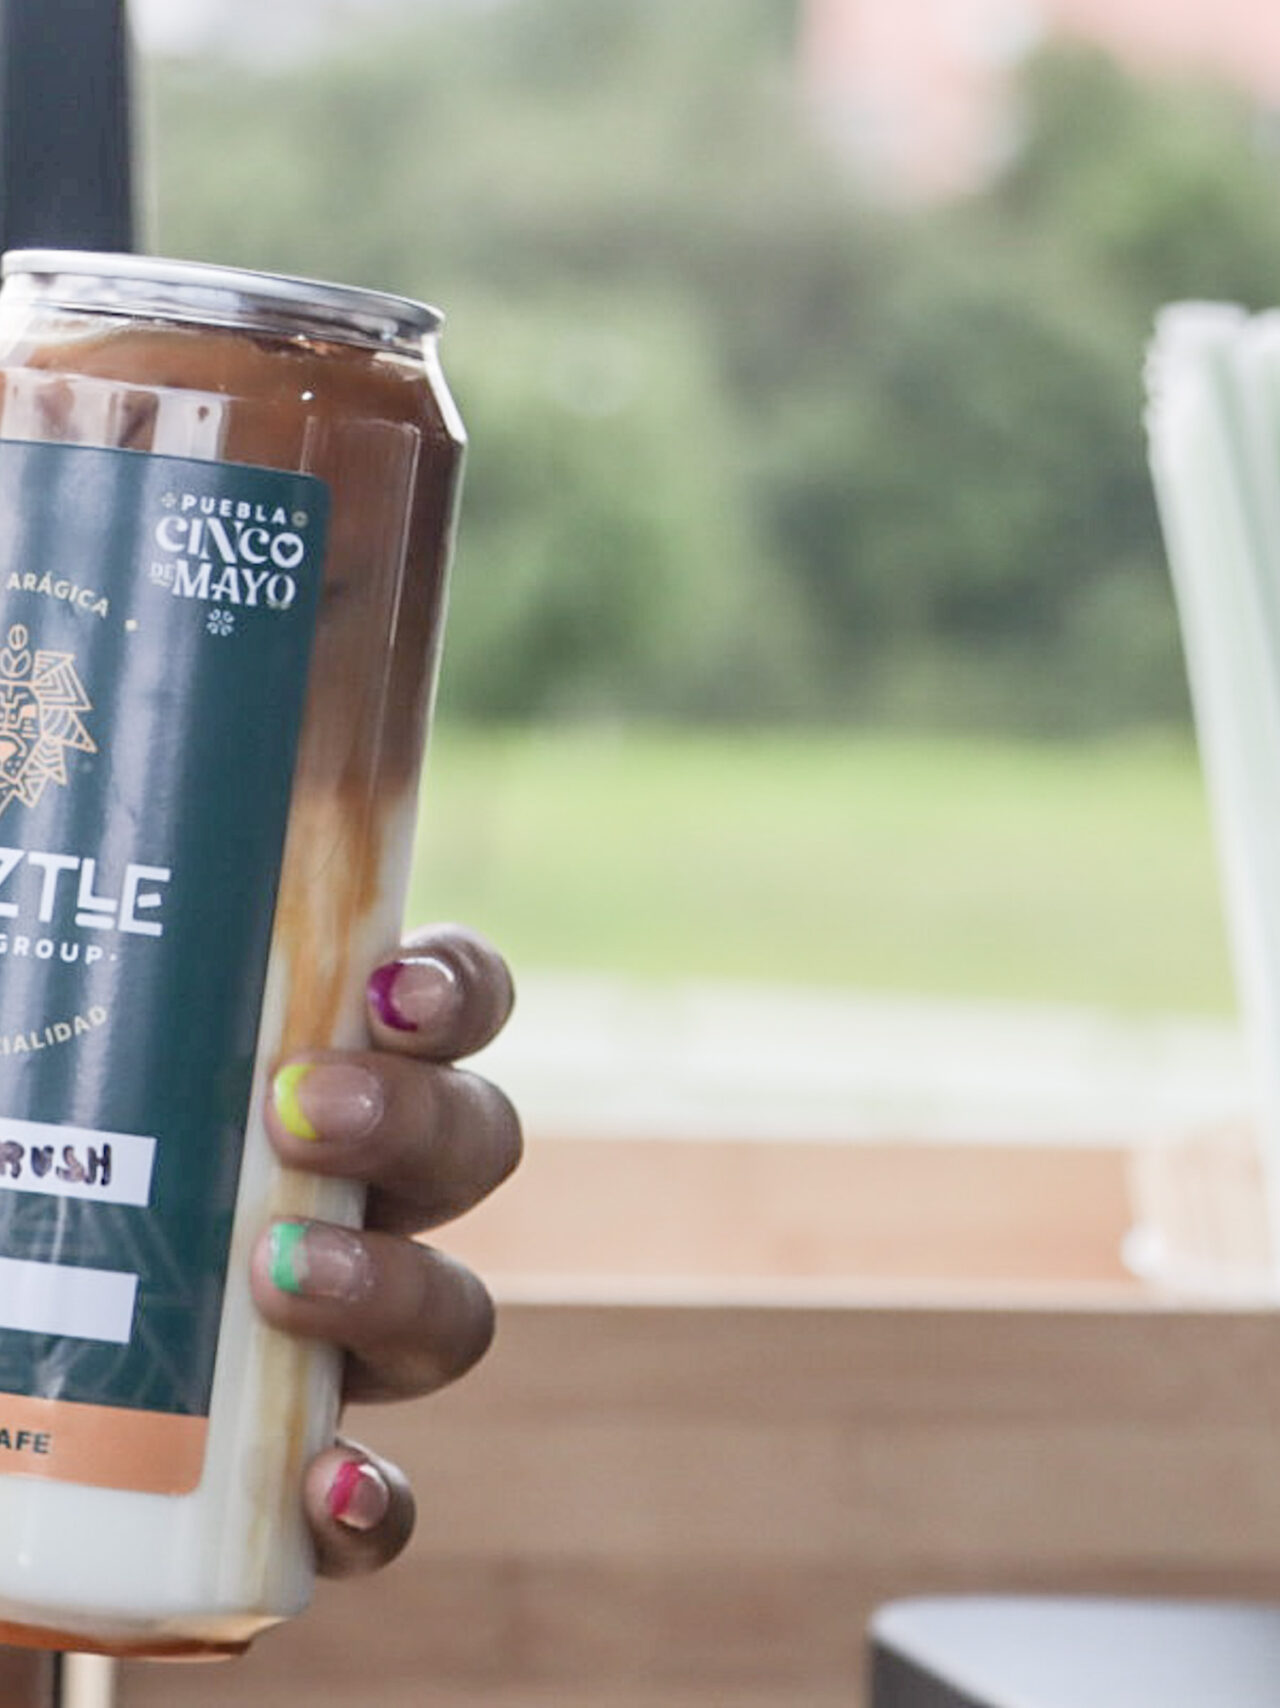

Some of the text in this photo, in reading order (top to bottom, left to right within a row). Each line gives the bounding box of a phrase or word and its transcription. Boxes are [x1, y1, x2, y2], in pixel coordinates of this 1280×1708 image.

[181, 493, 286, 525] PUEBLA
[155, 515, 304, 569] CINCO
[171, 558, 296, 609] MAYO
